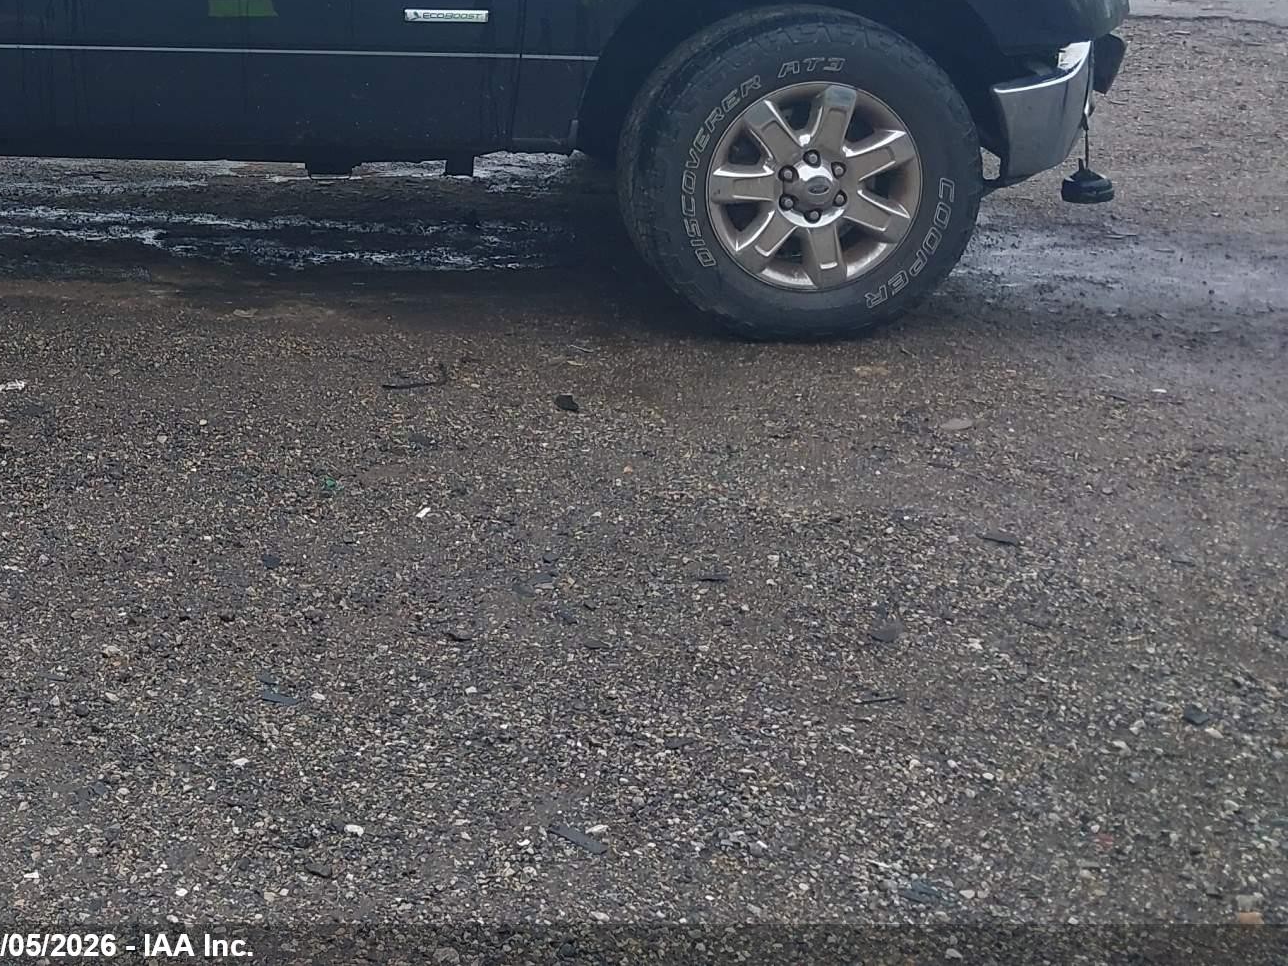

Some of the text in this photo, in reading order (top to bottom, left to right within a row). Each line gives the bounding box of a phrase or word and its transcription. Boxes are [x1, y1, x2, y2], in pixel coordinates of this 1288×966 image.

[680, 56, 847, 268] DISCOVERER AT3
[863, 176, 956, 309] COOPER
